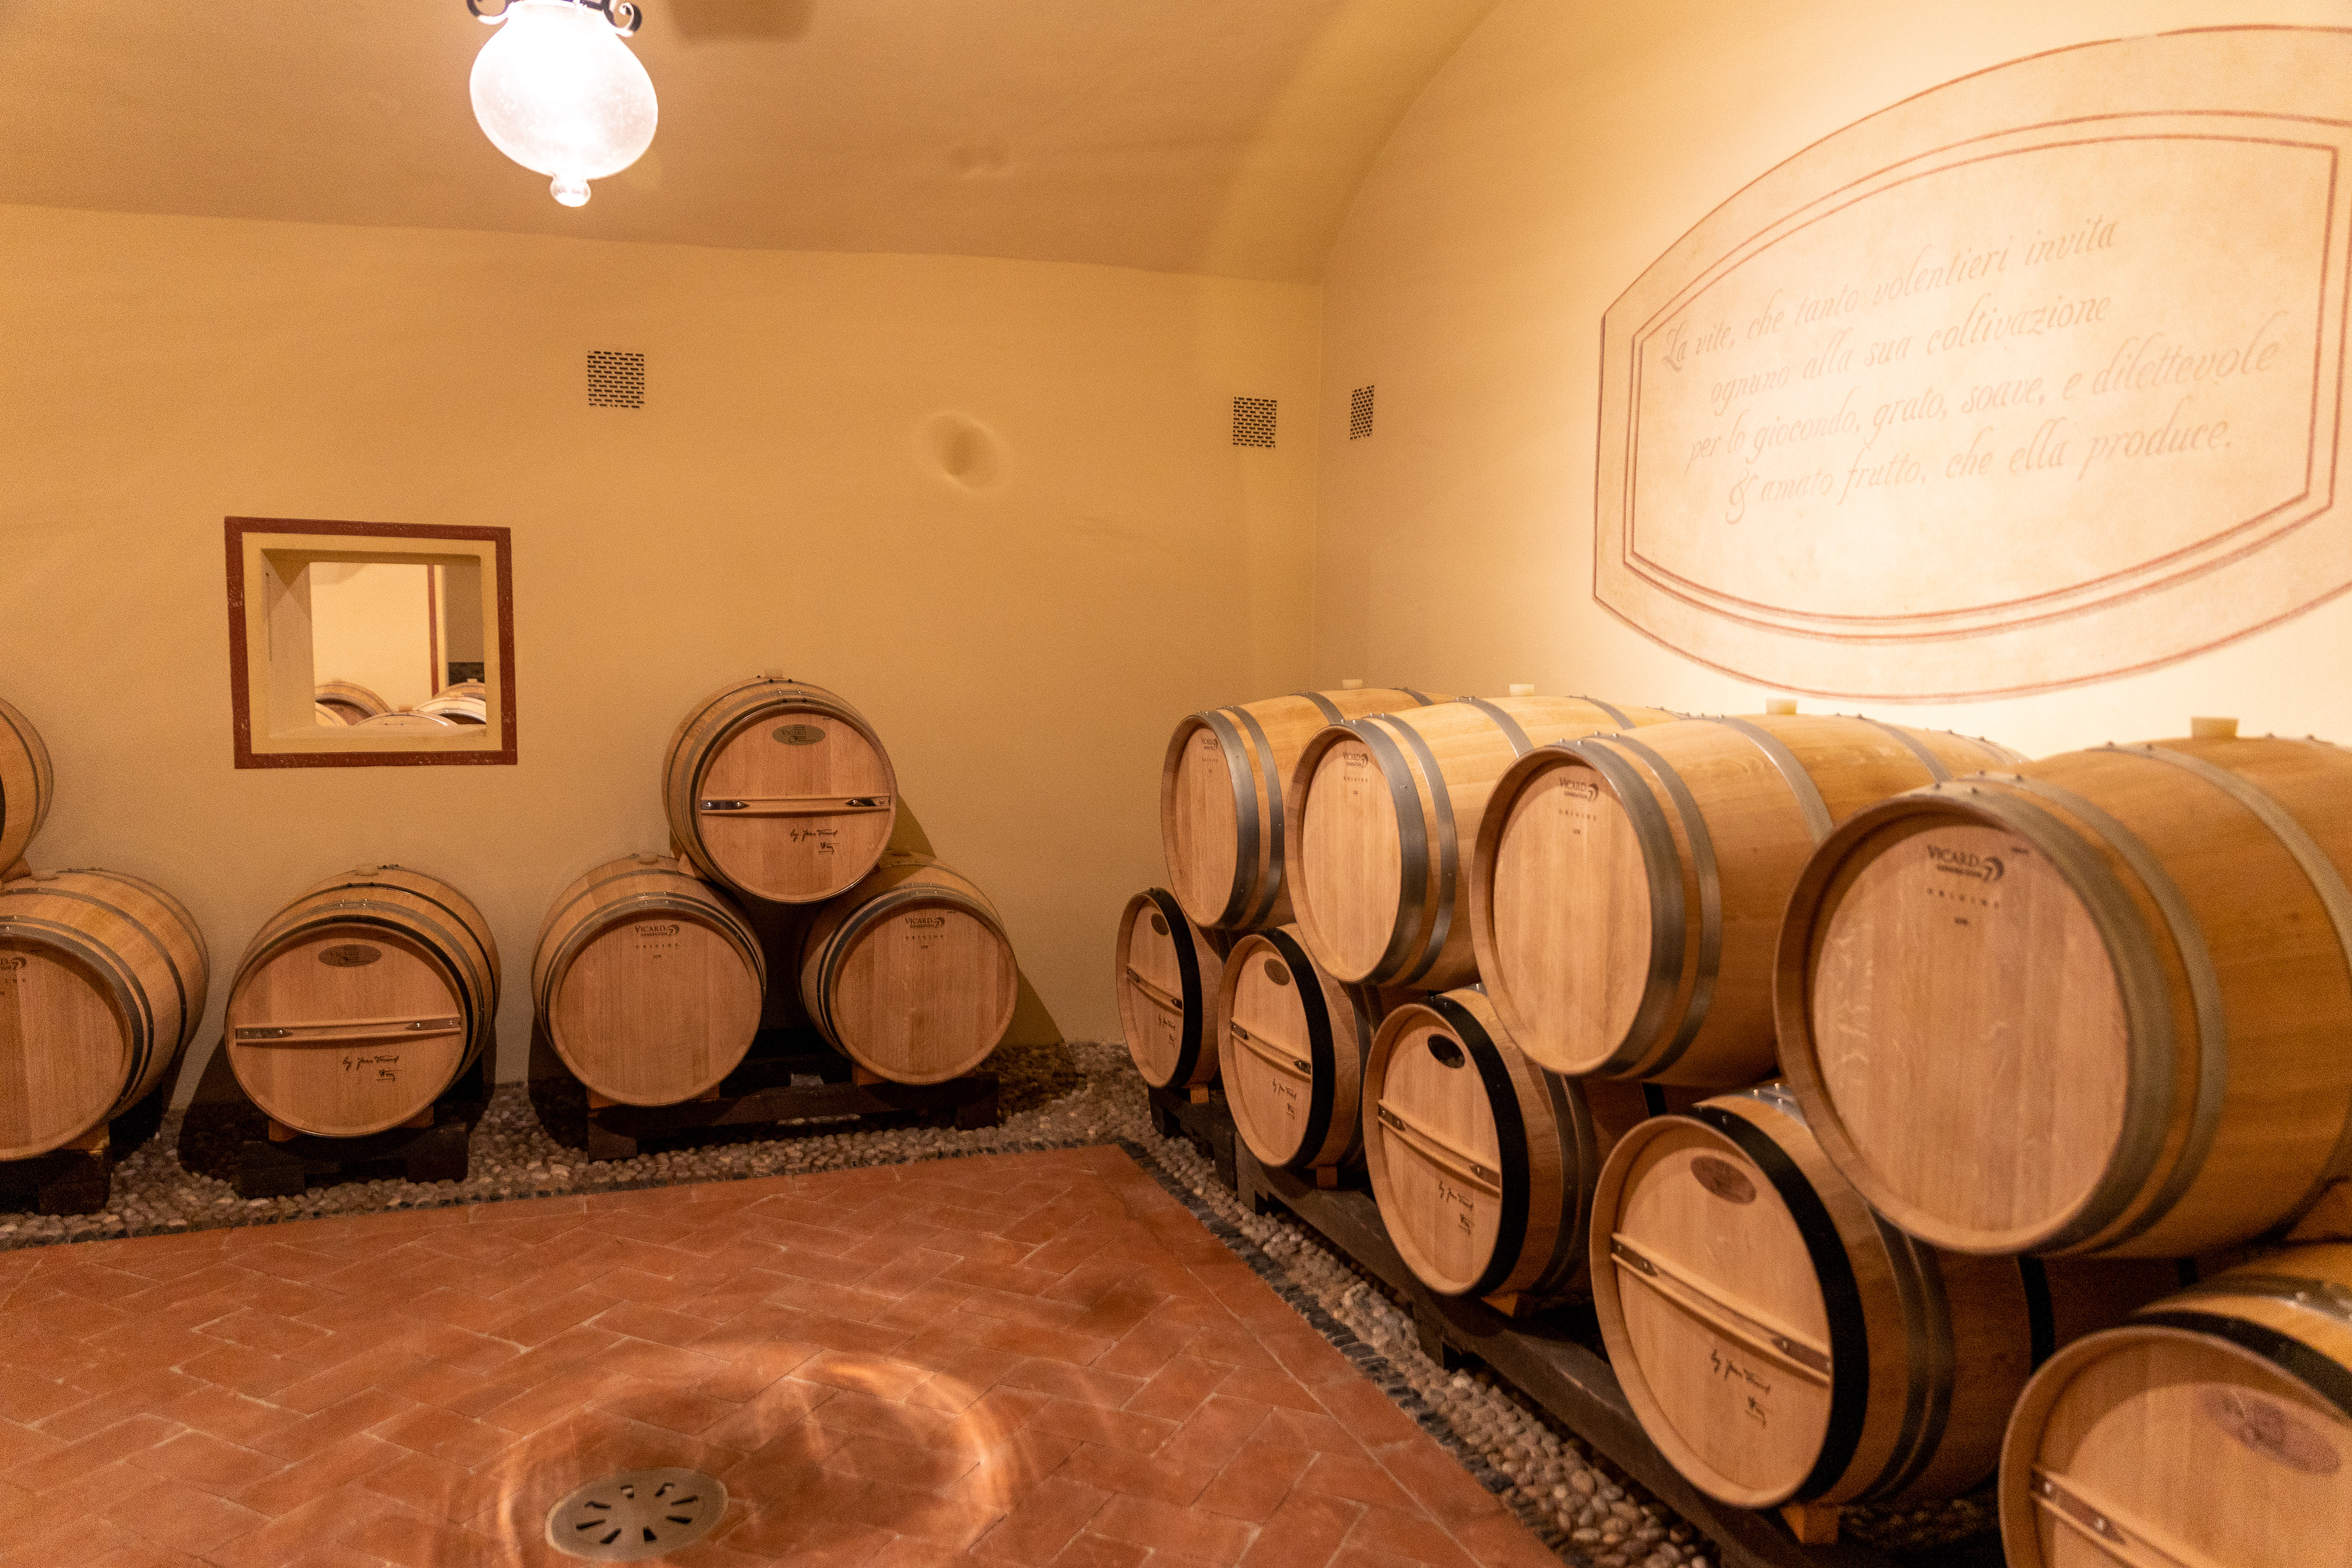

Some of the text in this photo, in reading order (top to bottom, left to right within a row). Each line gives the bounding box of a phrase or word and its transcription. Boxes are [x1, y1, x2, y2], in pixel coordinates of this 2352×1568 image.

[1661, 214, 2118, 372] La vite, che tanto volentieri invita
[1711, 292, 2111, 417] ognuno alla sua coltivazione
[1684, 309, 2289, 476] per lo giocondo, grato, soave, e dilettevole
[1760, 467, 1833, 502] amato
[1836, 446, 1926, 506] frutto,
[1945, 424, 1994, 479] che
[2008, 417, 2069, 475] ella
[2076, 394, 2232, 481] produce.
[635, 925, 666, 933] VICARD
